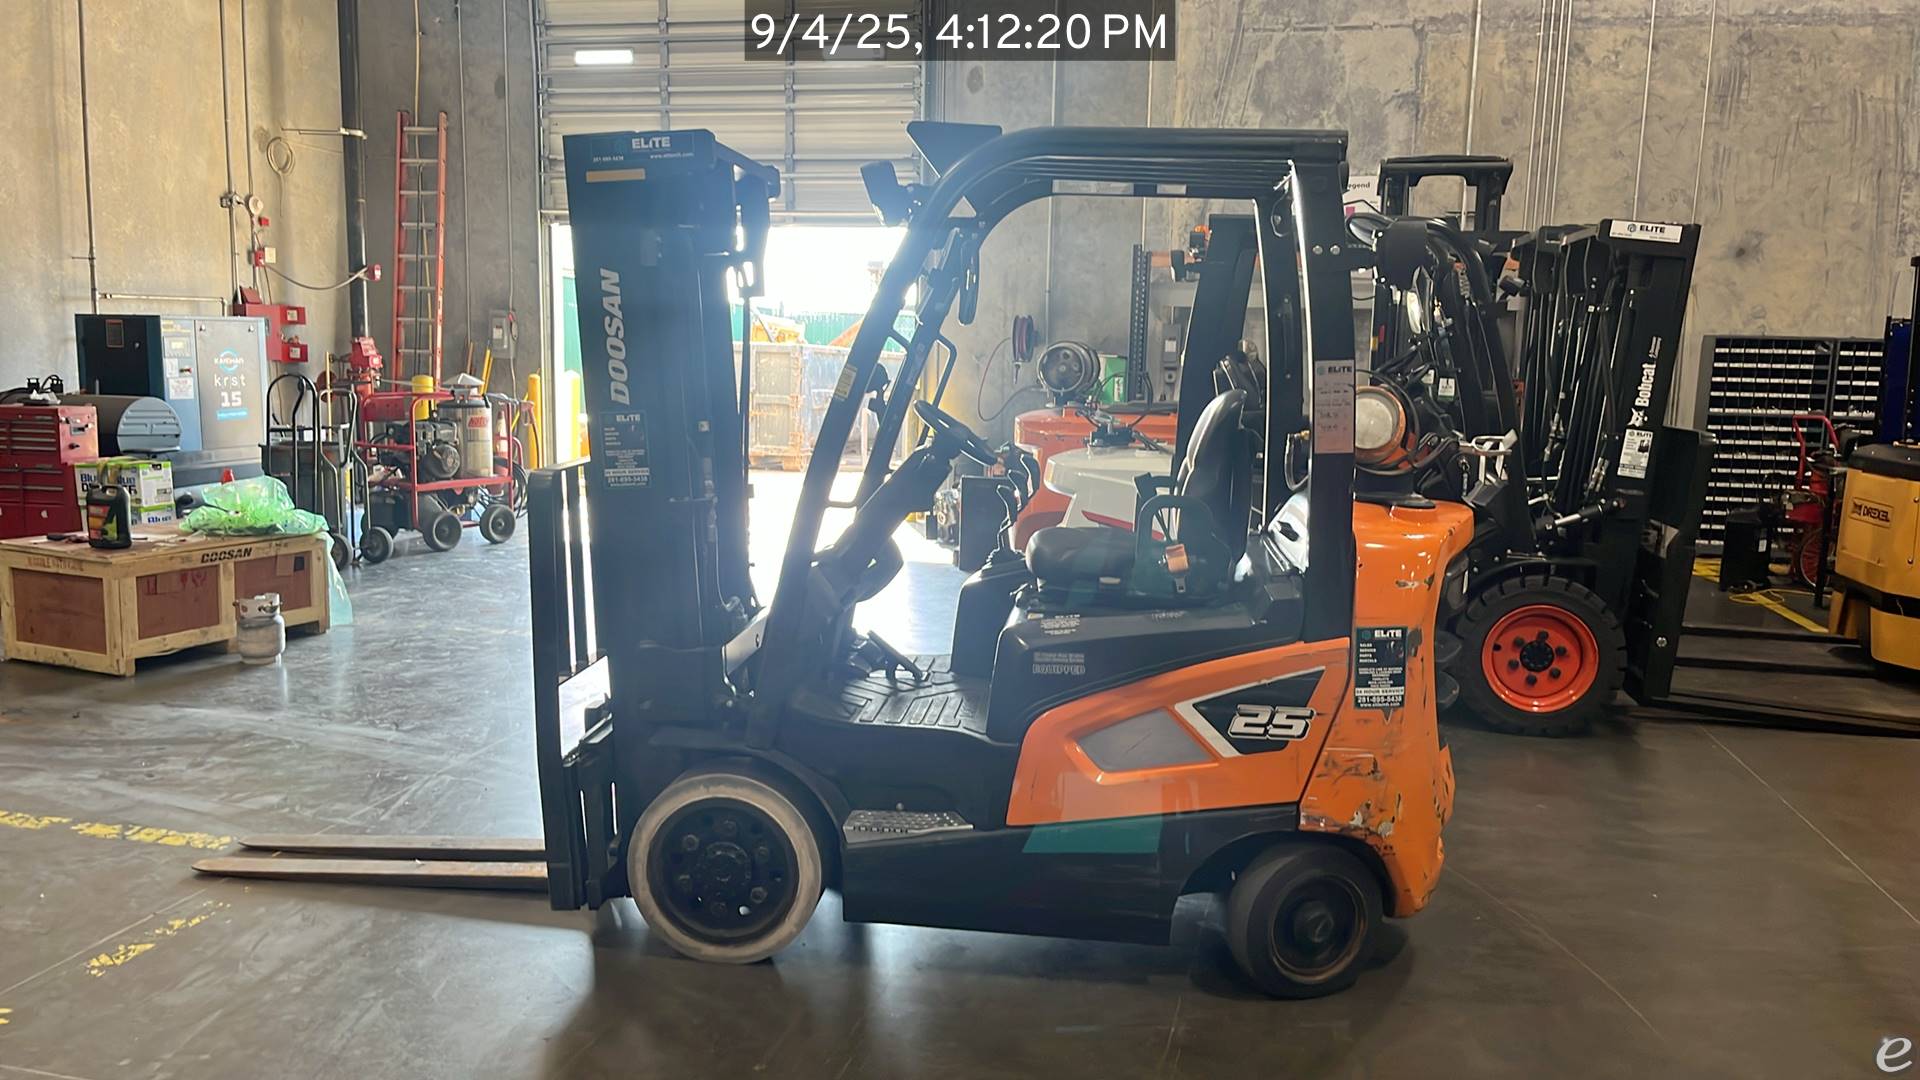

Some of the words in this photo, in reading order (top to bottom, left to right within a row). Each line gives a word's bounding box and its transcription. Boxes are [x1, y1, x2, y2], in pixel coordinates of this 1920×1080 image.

[632, 136, 671, 149] ELITE
[1347, 181, 1371, 190] egend
[1640, 225, 1666, 233] ELITE
[600, 267, 630, 406] DOOSAN
[1328, 366, 1353, 374] ELITE
[214, 373, 246, 387] krst
[1634, 362, 1657, 407] Bobcat
[221, 391, 242, 407] 15
[616, 414, 641, 422] ELITE
[201, 547, 252, 563] DOOSAN
[1374, 629, 1402, 638] ELITE
[1228, 704, 1316, 740] 25
